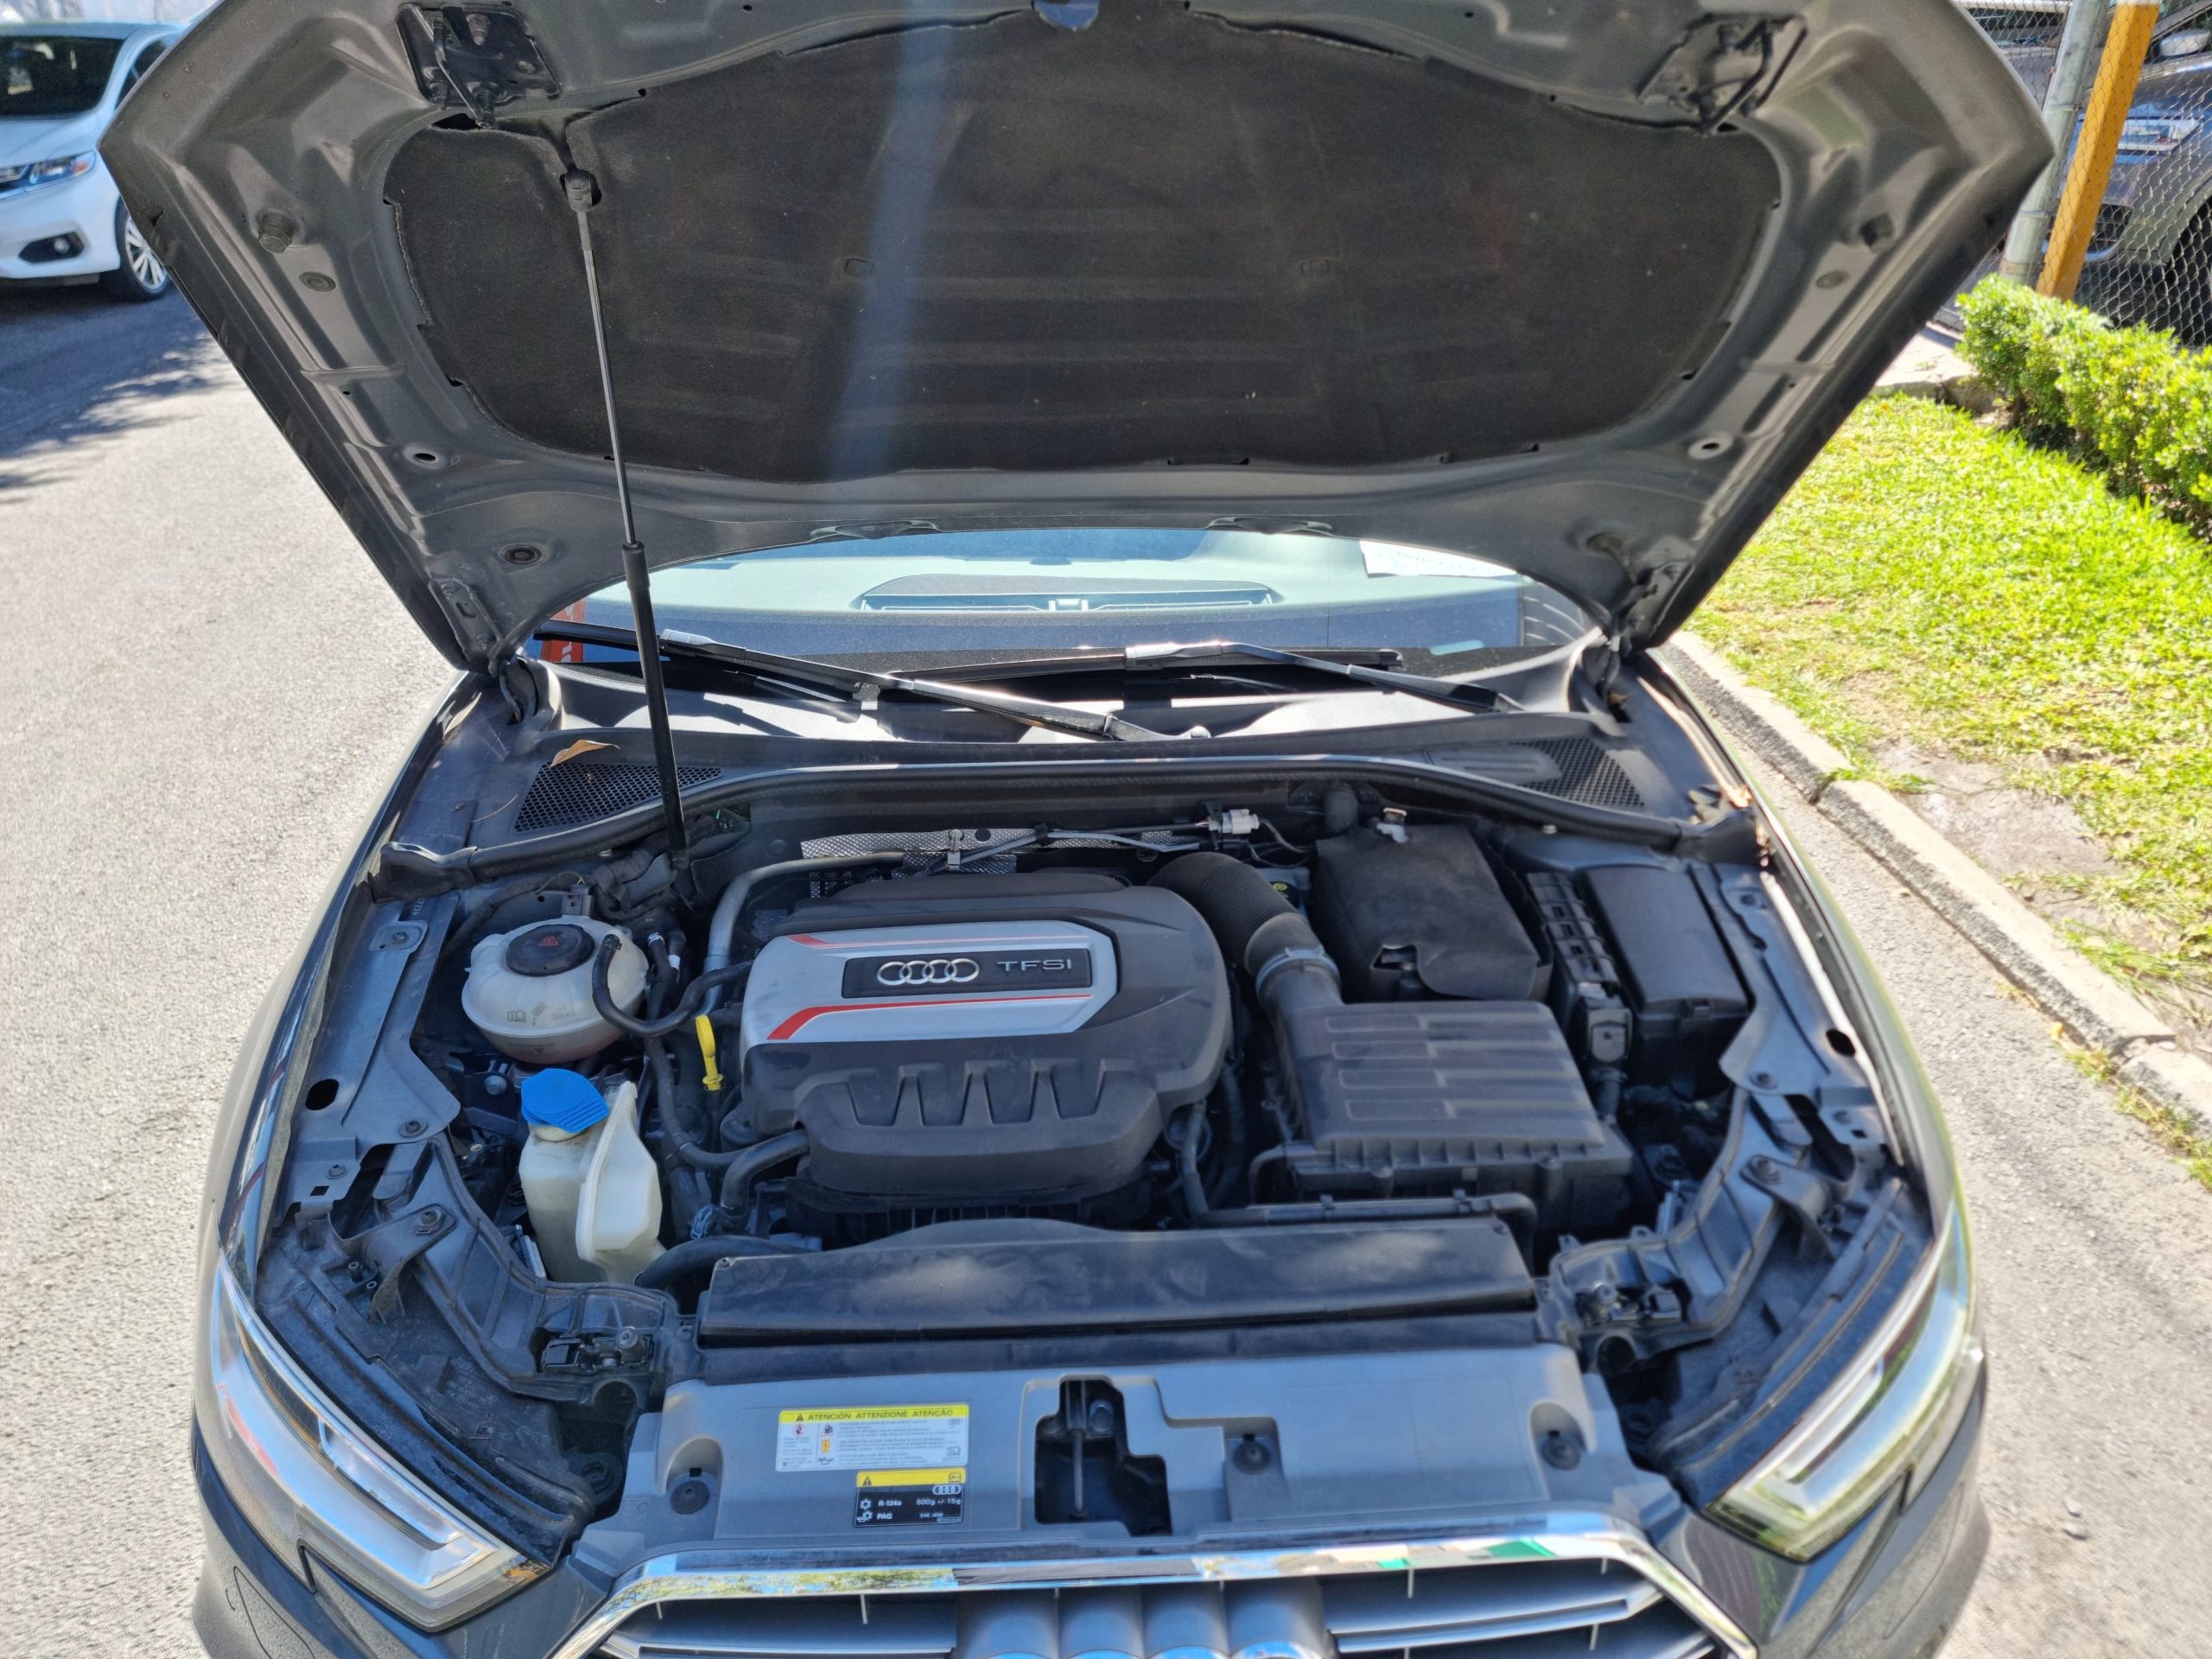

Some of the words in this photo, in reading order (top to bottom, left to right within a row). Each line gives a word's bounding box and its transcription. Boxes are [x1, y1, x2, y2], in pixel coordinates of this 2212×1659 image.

[996, 958, 1072, 971] TFSI
[807, 1413, 851, 1421] ATENCIÓN
[912, 1409, 953, 1418] ATENÇÃO
